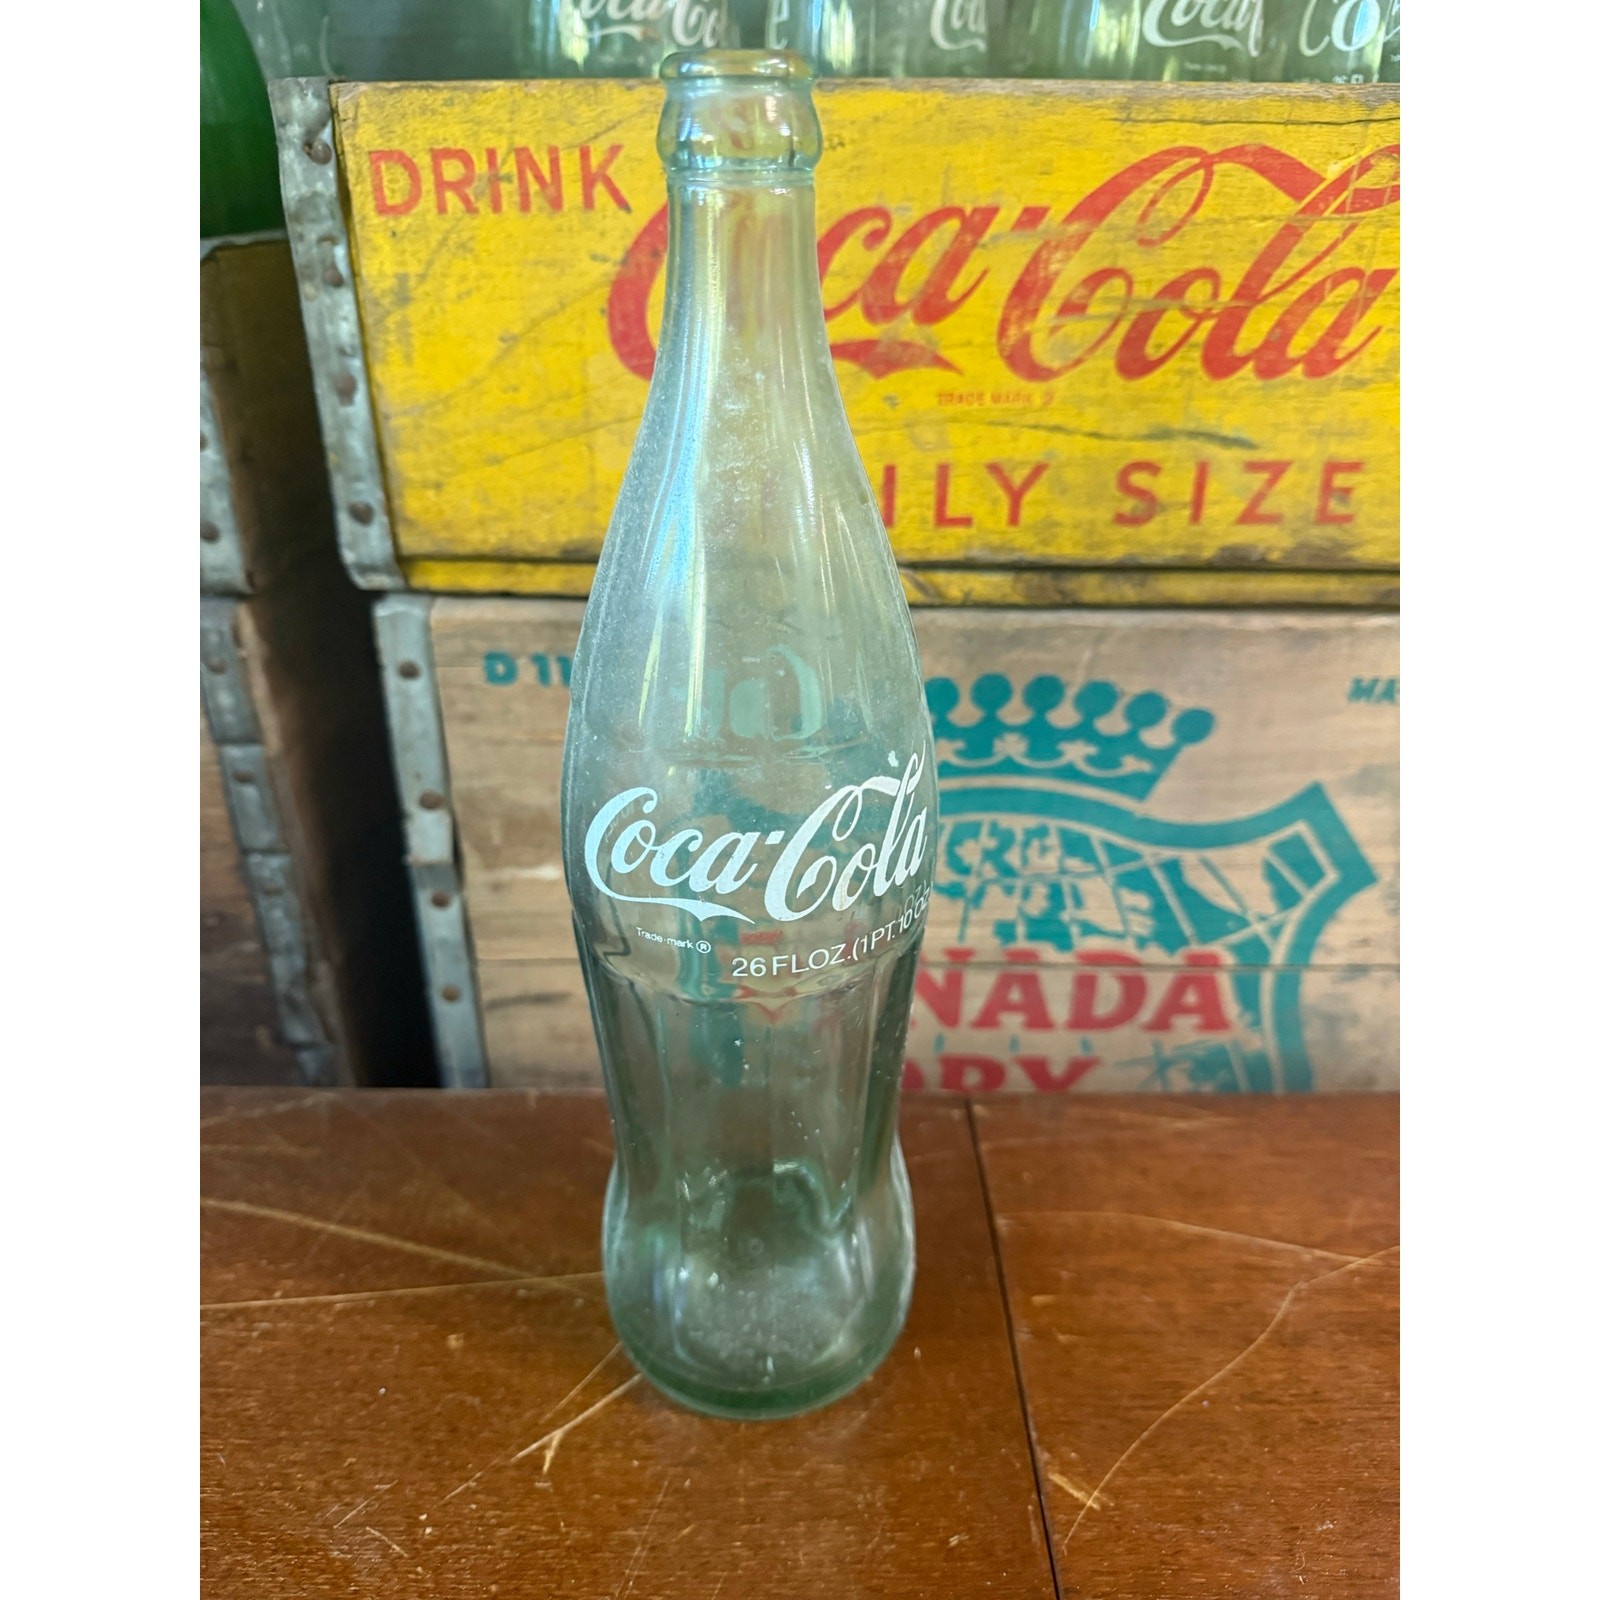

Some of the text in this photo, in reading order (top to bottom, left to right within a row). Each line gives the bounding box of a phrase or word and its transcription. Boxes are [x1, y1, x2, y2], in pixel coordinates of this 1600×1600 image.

[368, 144, 632, 217] DRINK
[1112, 459, 1365, 527] SIZE
[584, 739, 928, 923] Coca-Cola
[732, 957, 767, 977] 26
